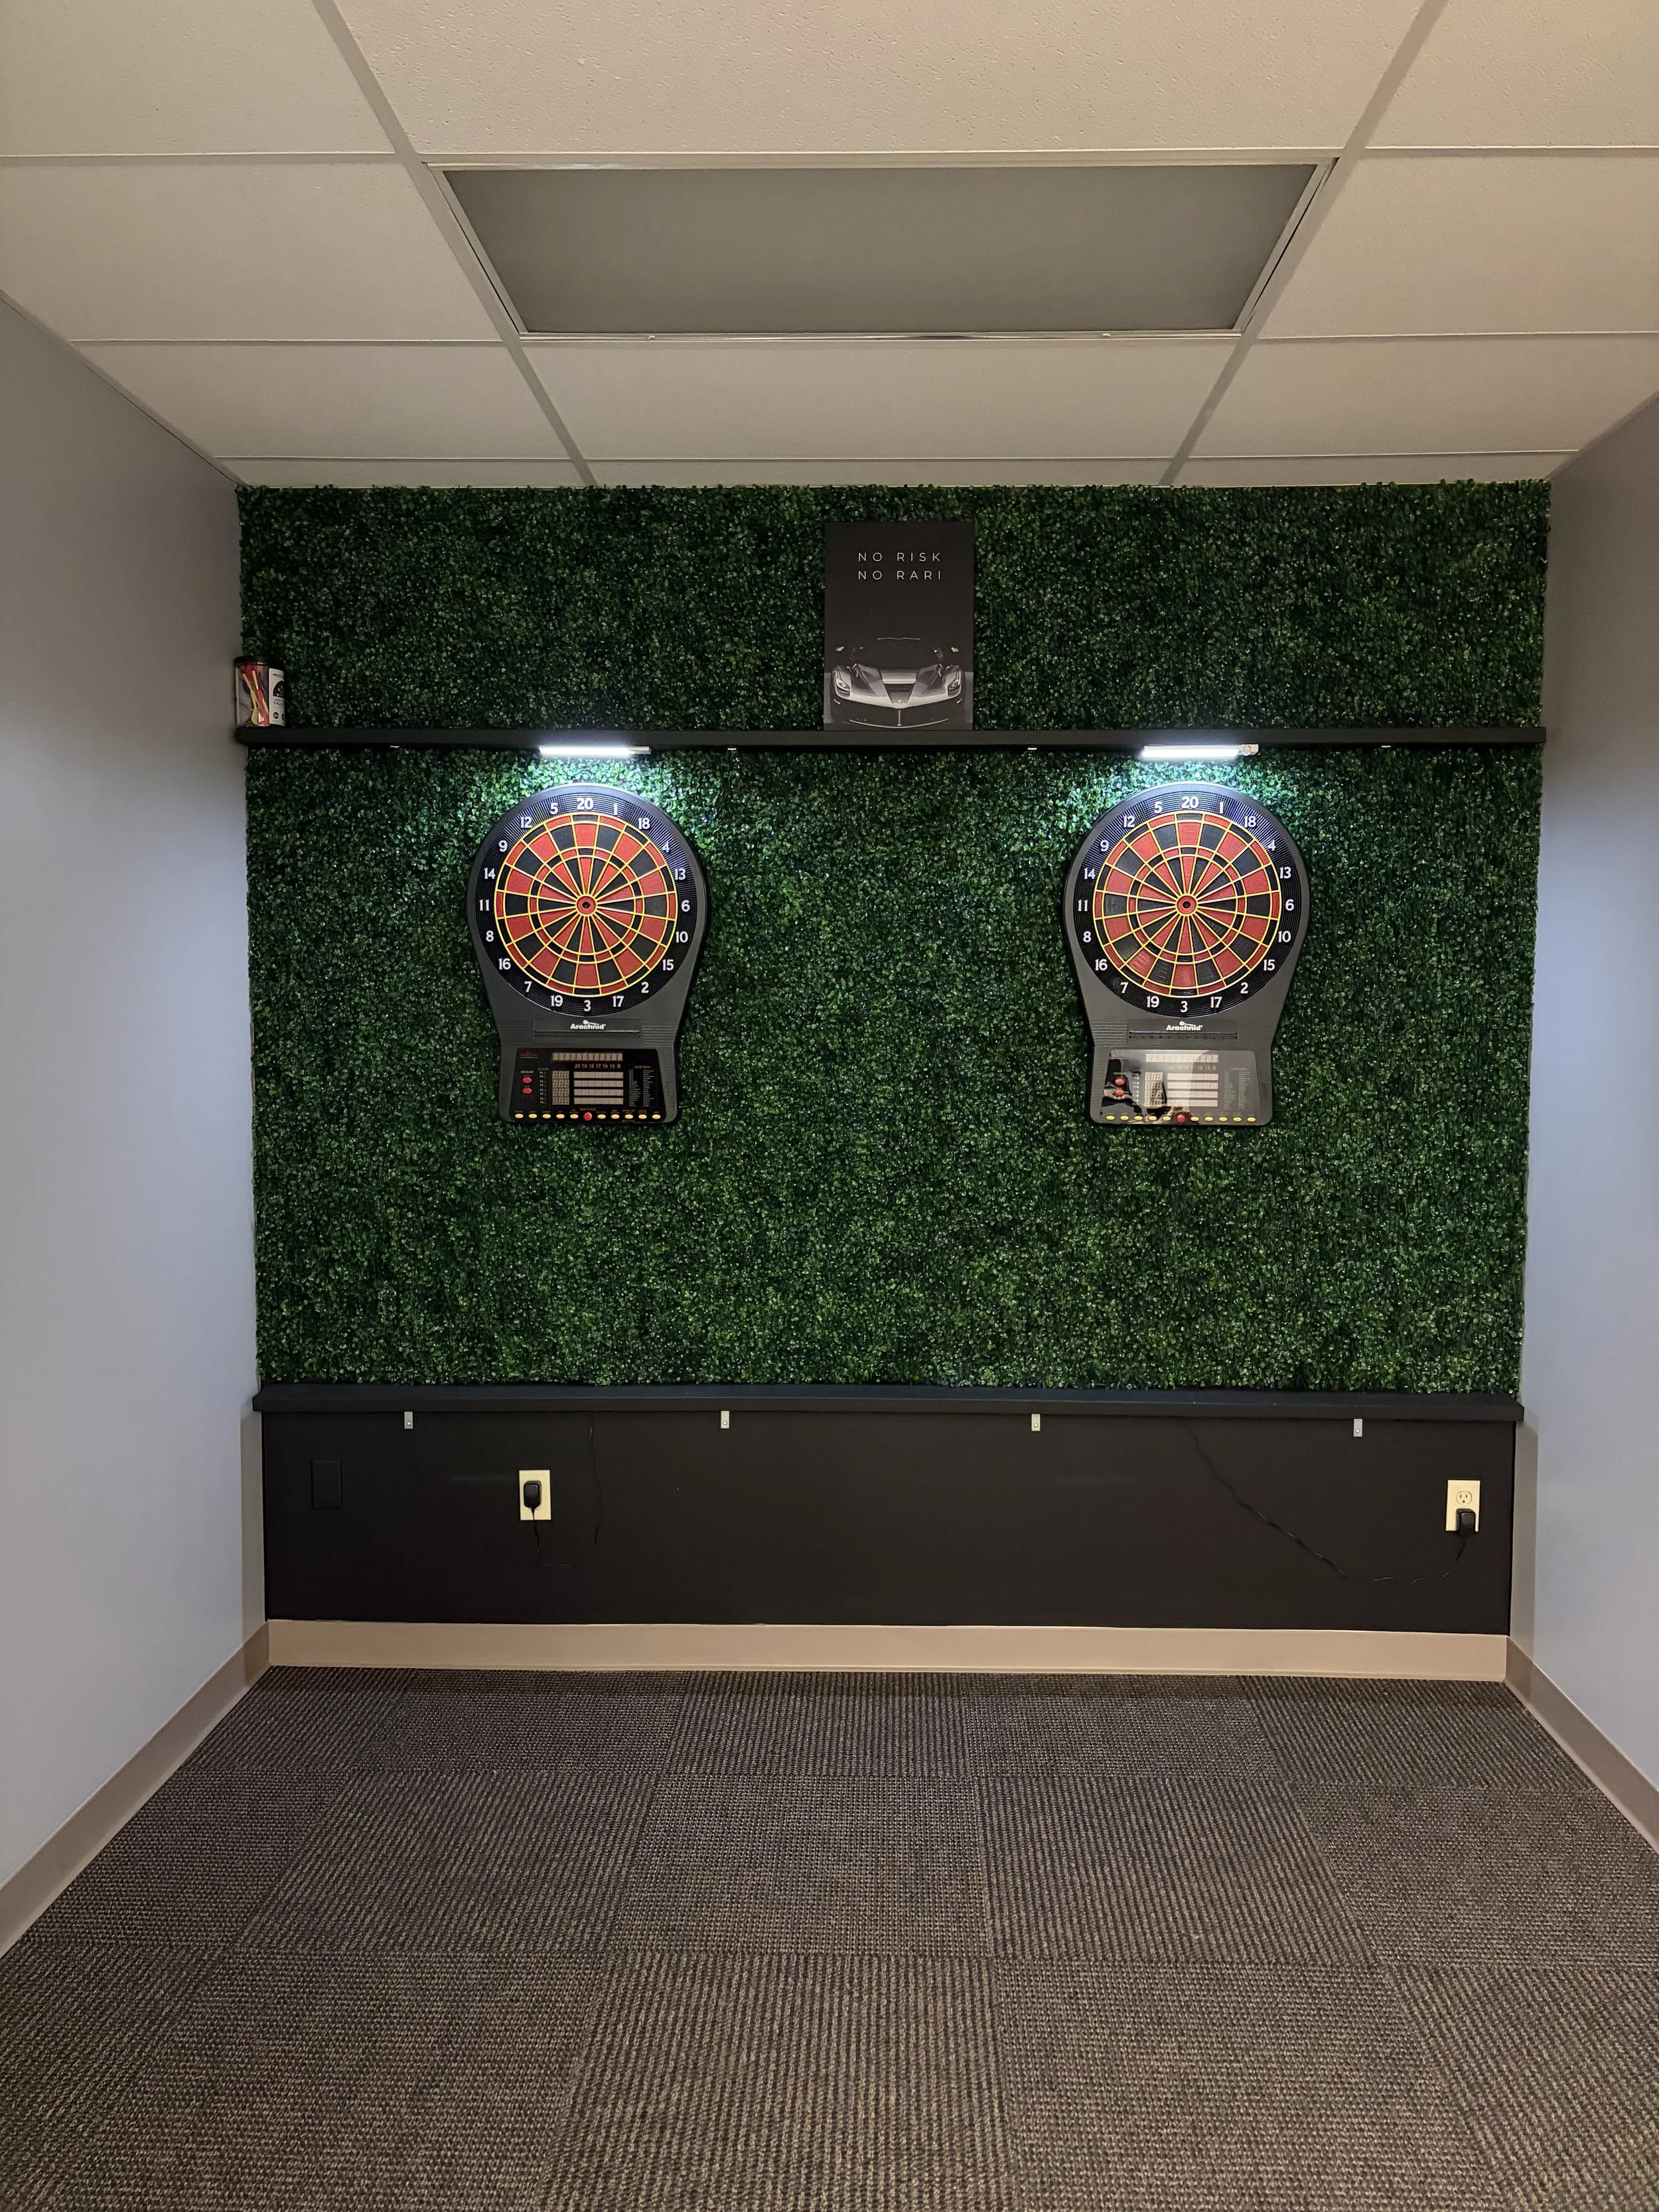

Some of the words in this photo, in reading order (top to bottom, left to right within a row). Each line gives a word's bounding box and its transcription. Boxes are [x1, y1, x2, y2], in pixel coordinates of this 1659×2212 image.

[858, 552, 883, 562] NO
[897, 552, 940, 562] RISK
[857, 570, 883, 580] NO
[897, 570, 940, 580] RARI
[549, 802, 559, 815] 5
[577, 797, 595, 810] 20
[1153, 802, 1163, 814] 5
[1181, 796, 1199, 809] 20
[1219, 802, 1224, 814] 1
[613, 804, 618, 816] 1
[520, 817, 532, 828] 12
[638, 818, 651, 830] 18
[1122, 816, 1135, 828] 12
[1243, 816, 1257, 828] 18
[498, 840, 508, 852] 9
[662, 842, 670, 853] 4
[1099, 840, 1110, 852] 9
[1267, 841, 1277, 852] 4
[483, 868, 496, 880] 14
[674, 869, 687, 880] 13
[1083, 868, 1096, 880] 14
[1279, 867, 1292, 879] 13
[479, 899, 490, 911] 11
[680, 900, 691, 912] 6
[1077, 899, 1088, 912] 11
[1284, 899, 1295, 911] 6
[485, 930, 494, 942] 8
[676, 931, 689, 943] 10
[1082, 930, 1092, 943] 8
[1278, 930, 1292, 942] 10
[498, 958, 512, 970] 16
[662, 959, 674, 971] 15
[1094, 959, 1108, 971] 16
[1263, 959, 1275, 971] 15
[524, 982, 532, 993] 7
[640, 982, 650, 994] 2
[1119, 982, 1129, 994] 7
[1240, 982, 1249, 994] 2
[550, 995, 564, 1008] 19
[583, 1000, 592, 1013] 3
[612, 995, 624, 1008] 17
[1146, 995, 1159, 1008] 19
[1180, 1001, 1188, 1013] 3
[1210, 995, 1223, 1008] 17
